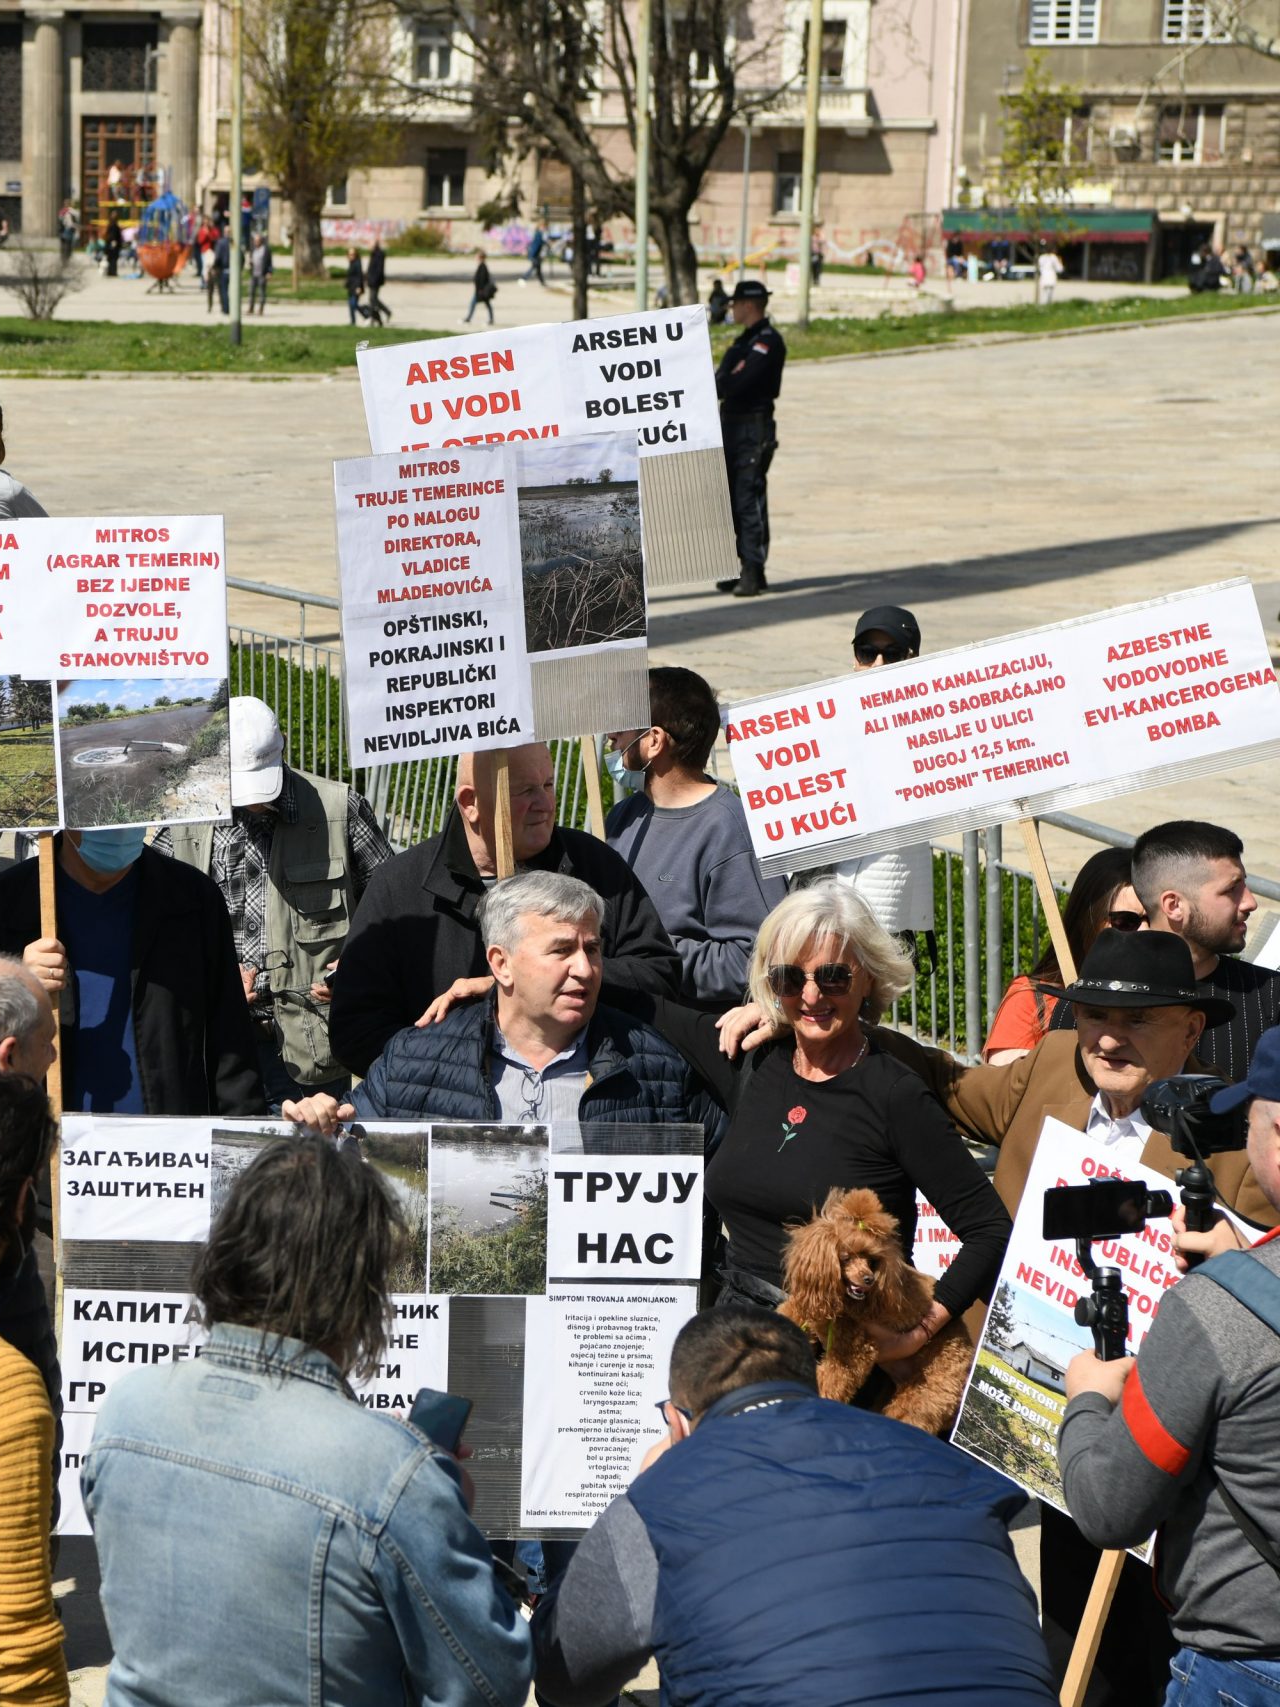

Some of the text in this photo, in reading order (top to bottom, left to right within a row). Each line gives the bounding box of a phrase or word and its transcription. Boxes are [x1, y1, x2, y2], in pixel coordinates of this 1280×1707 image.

[571, 323, 683, 353] ARSEN U
[406, 349, 515, 386] ARSEN
[600, 359, 661, 383] VODI
[410, 390, 521, 425] U VODI
[585, 390, 684, 419] BOLEST
[398, 460, 461, 479] MITROS
[355, 480, 505, 508] TRUJE TEMERINCE
[387, 507, 480, 529] PO NALOGU
[95, 528, 170, 543] MITROS
[384, 532, 480, 554] DIREKTORA,
[47, 552, 220, 572] (AGRAR TEMERIN)
[402, 557, 470, 576] VLADICE
[77, 577, 190, 593] BEZ IJEDNE
[377, 576, 492, 604] MLADENOVIĆA
[86, 603, 181, 619] DOZVOLE,
[383, 610, 488, 638] OPŠTINSKI,
[94, 627, 178, 642] A TRUJU
[1106, 623, 1212, 664] AZBESTNE
[59, 649, 209, 667] STANOVNIŠTVO
[369, 636, 505, 667] POKRAJINSKI I
[386, 664, 496, 694] REPUBLIČKI
[860, 653, 1053, 710] NEMAMO KANALIZACIJU,
[1103, 649, 1229, 693] VODOVODNE
[385, 693, 495, 722] INSPEKTORI
[864, 675, 1067, 735] ALI IMAMO SAOBRAĆAJNO
[364, 715, 521, 753] NEVIDLJIVA BIĆA
[724, 699, 837, 744] ARSEN U
[906, 708, 1034, 750] NASILJE U ULICI
[1146, 711, 1221, 742] BOMBA
[756, 740, 821, 771] VODI
[913, 734, 1035, 774] DUGOJ 12,5 km.
[746, 768, 848, 811] BOLEST
[895, 751, 1070, 802] "PONOSNI" TEMERINCI
[764, 802, 857, 842] U KUĆI
[63, 1150, 209, 1169] ЗАГАЂИВАЧ
[67, 1180, 205, 1199] ЗАШТИЋЕН
[555, 1172, 698, 1204] ТРУЈУ
[578, 1233, 674, 1265] НАС
[565, 1314, 592, 1322] Iritacija
[989, 1365, 1058, 1410] INSPEKTORI
[979, 1380, 1051, 1431] MOŽE DOBITI
[1032, 1434, 1040, 1446] U
